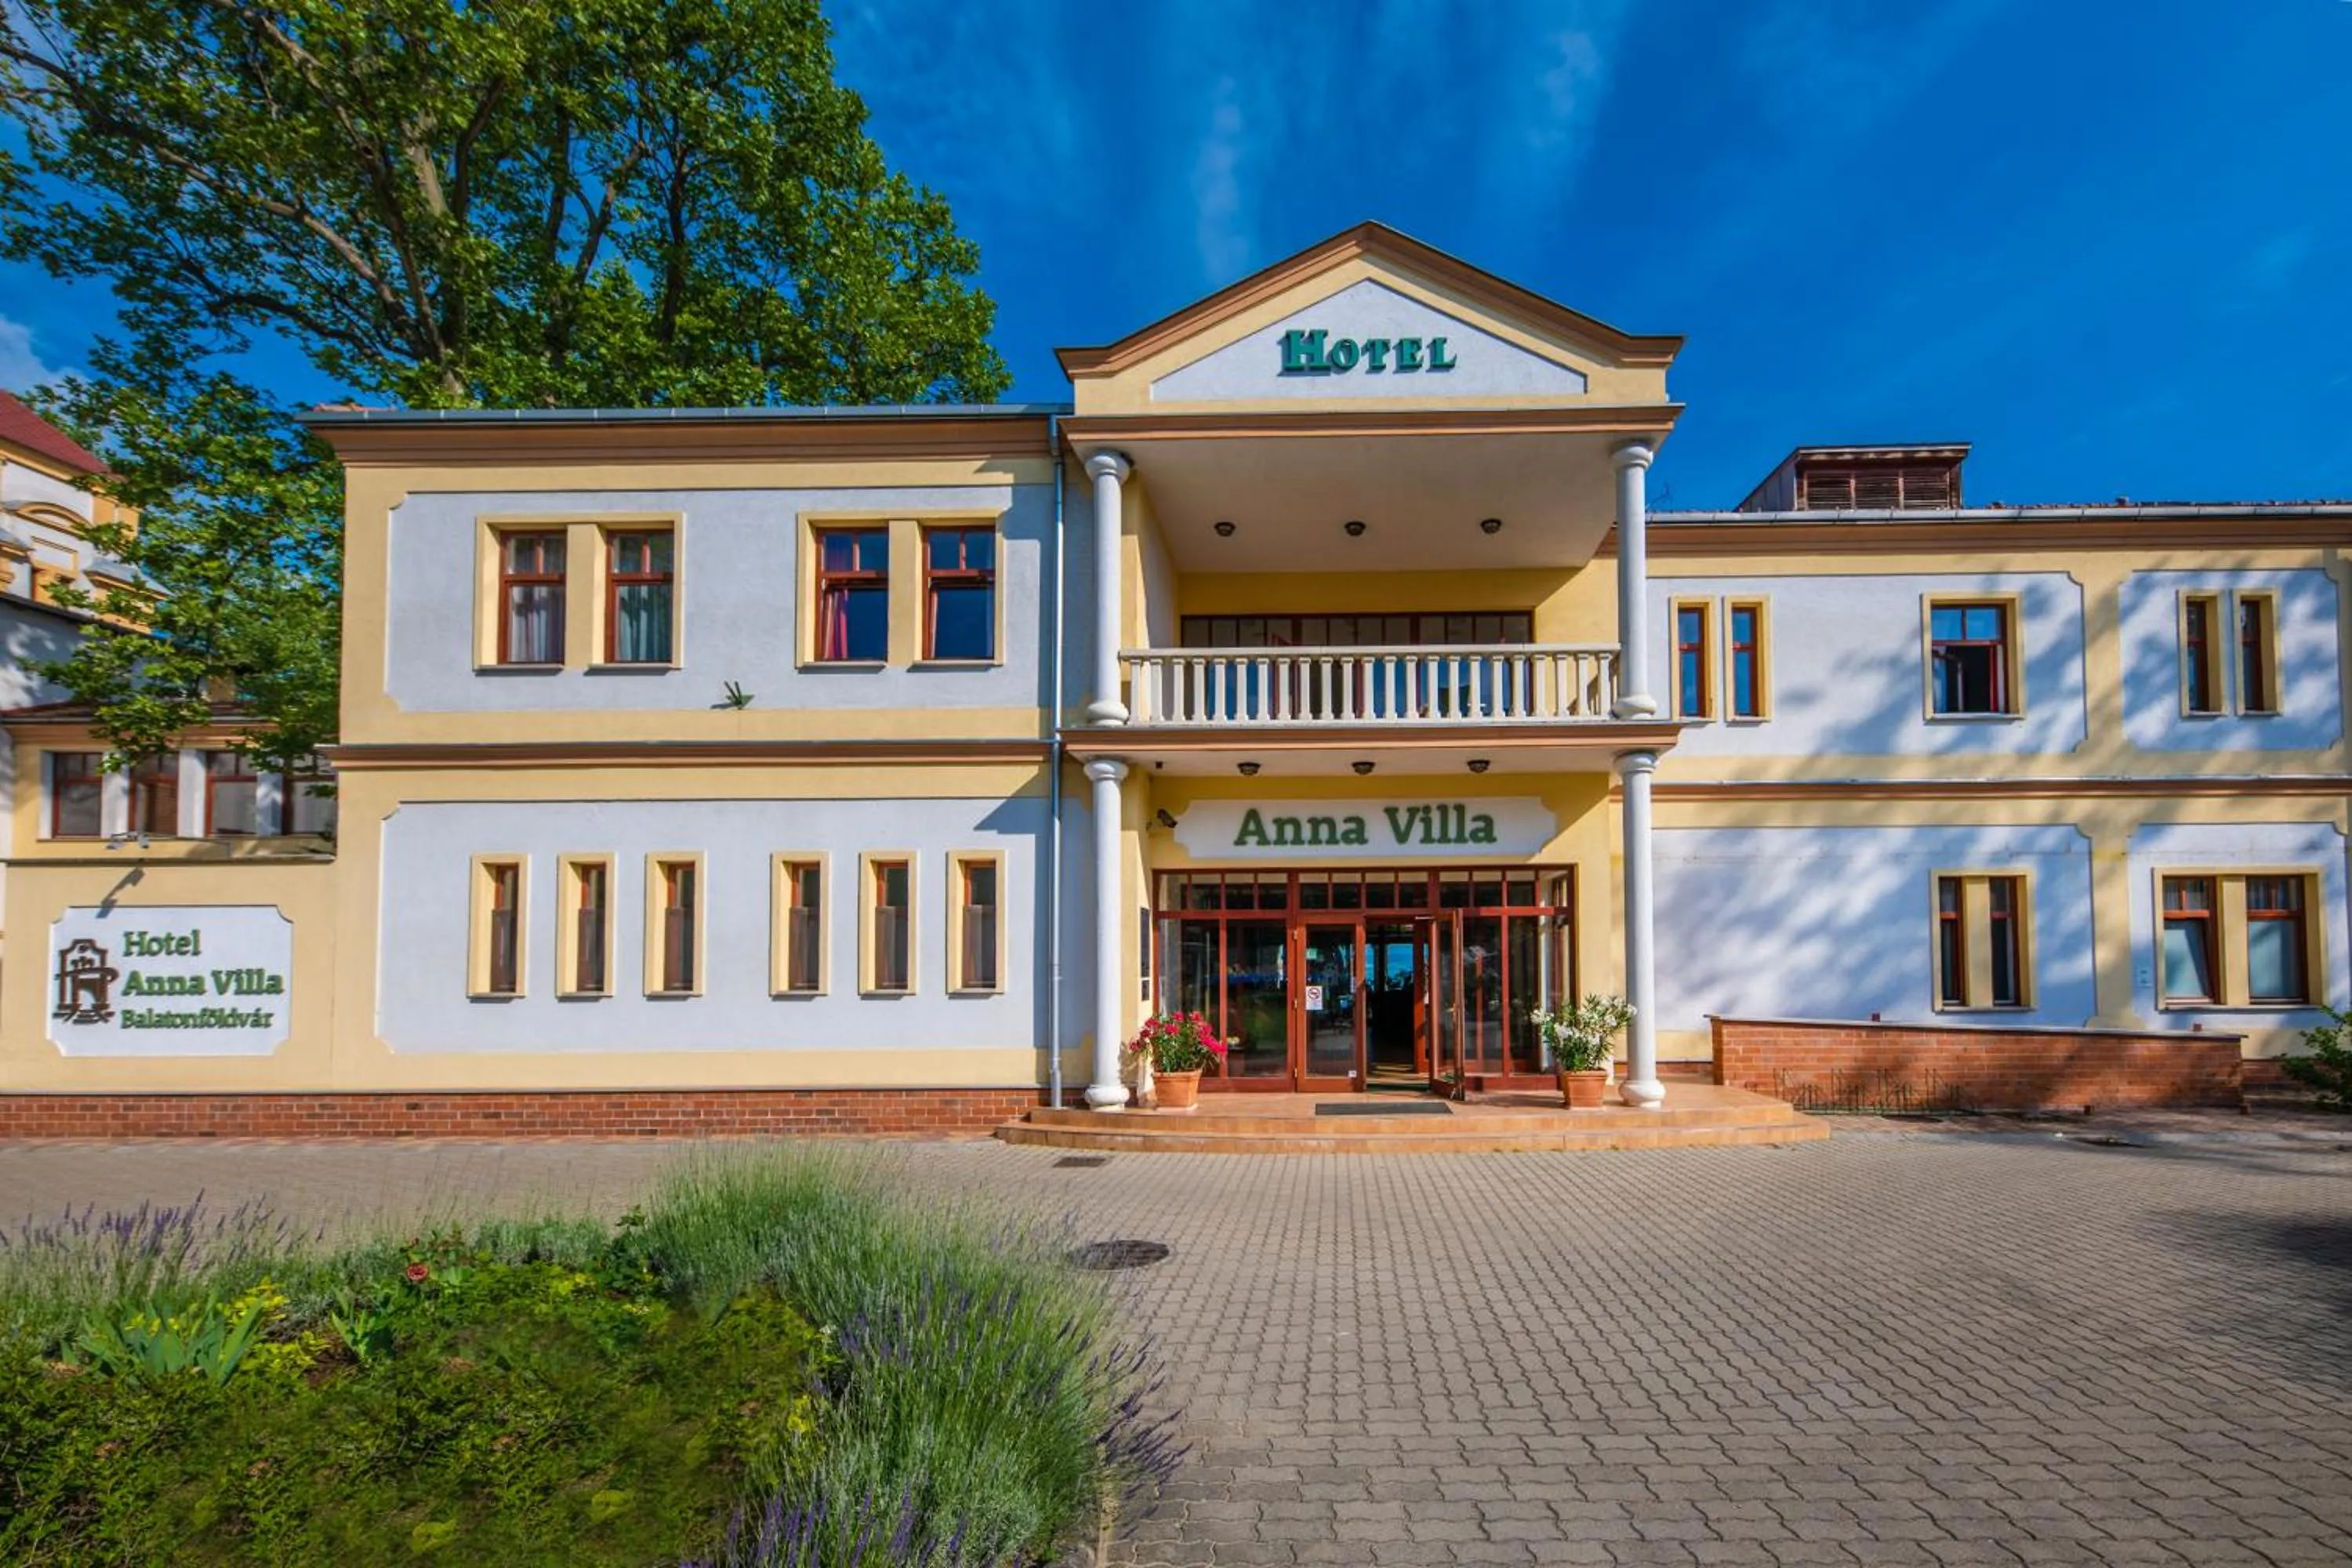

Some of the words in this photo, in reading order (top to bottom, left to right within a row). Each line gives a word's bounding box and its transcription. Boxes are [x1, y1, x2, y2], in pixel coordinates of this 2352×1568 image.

[1280, 329, 1457, 372] HOTEL
[1233, 808, 1369, 846] Anna
[1383, 804, 1497, 845] Villa
[122, 929, 201, 957] Hotel
[121, 970, 207, 996] Anna
[210, 967, 285, 996] Villa
[121, 1007, 274, 1029] Balatonföldvár
